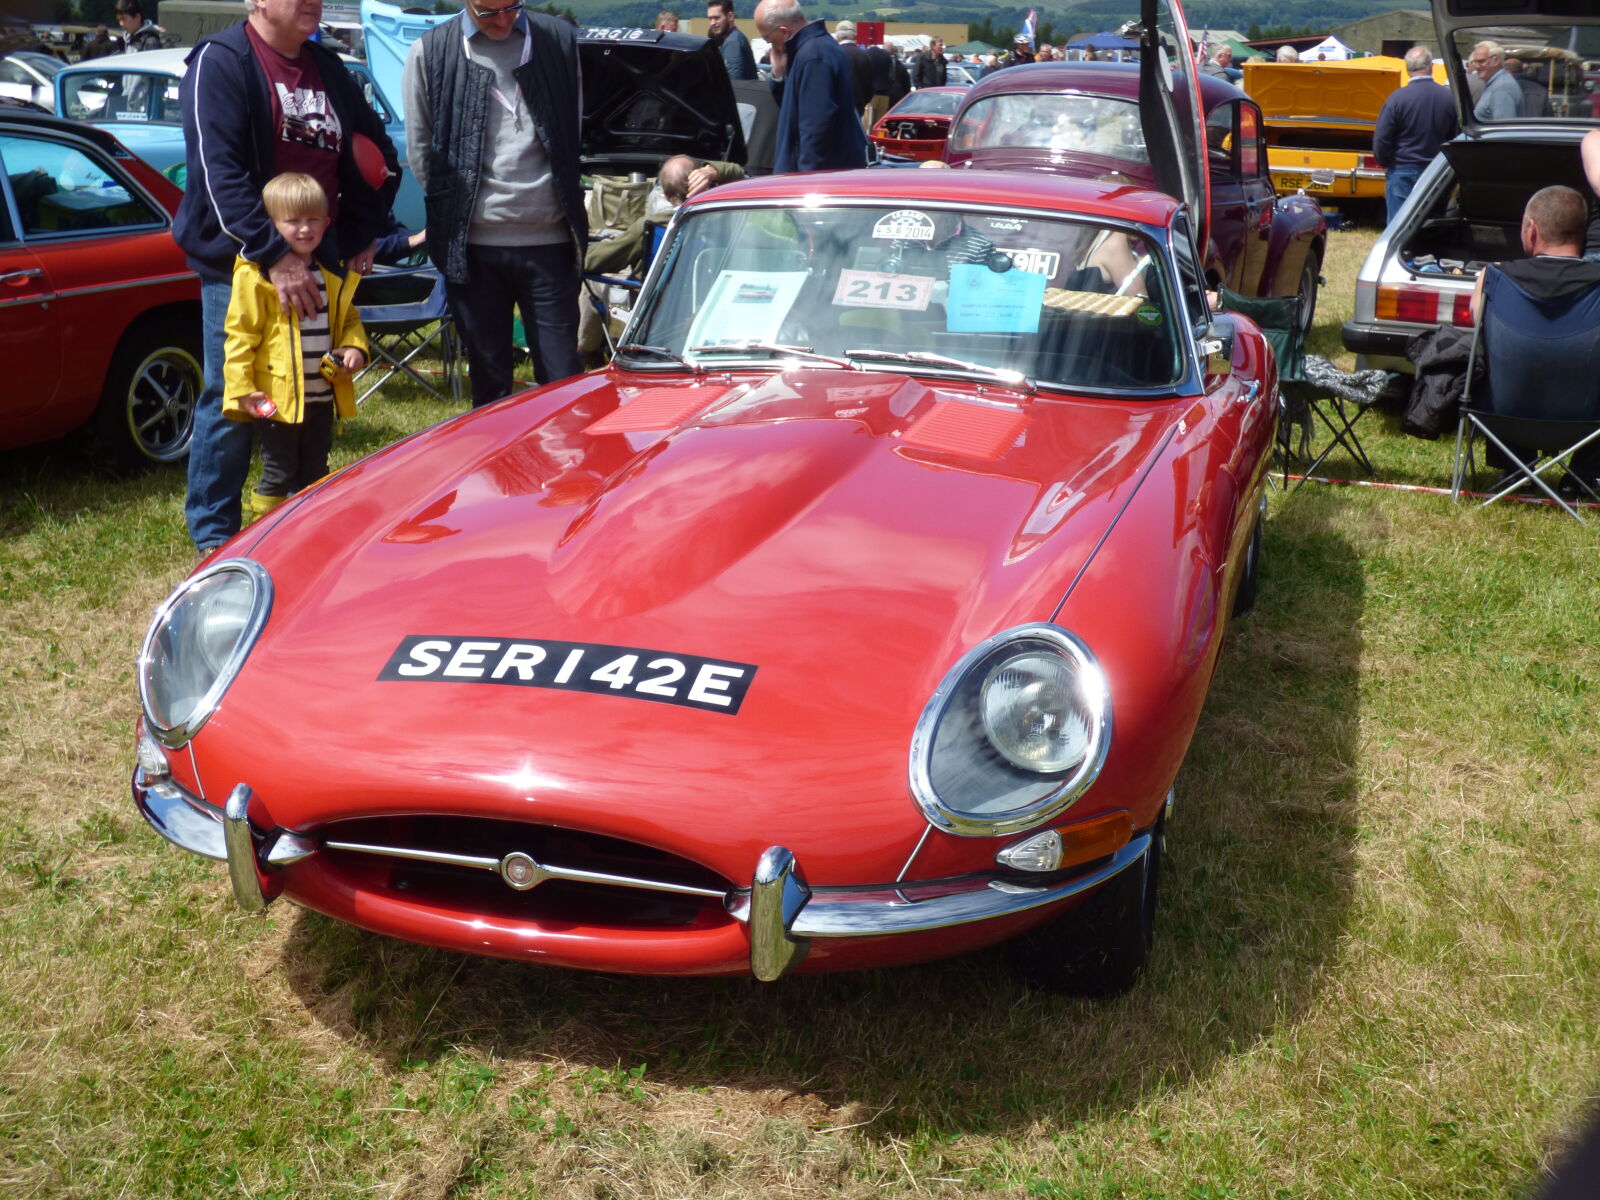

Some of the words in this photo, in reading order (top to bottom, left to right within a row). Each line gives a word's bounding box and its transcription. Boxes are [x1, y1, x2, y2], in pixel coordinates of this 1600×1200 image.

[1281, 177, 1303, 188] RSE
[904, 227, 931, 238] 2014
[1006, 252, 1051, 274] 91H
[847, 279, 918, 302] 213
